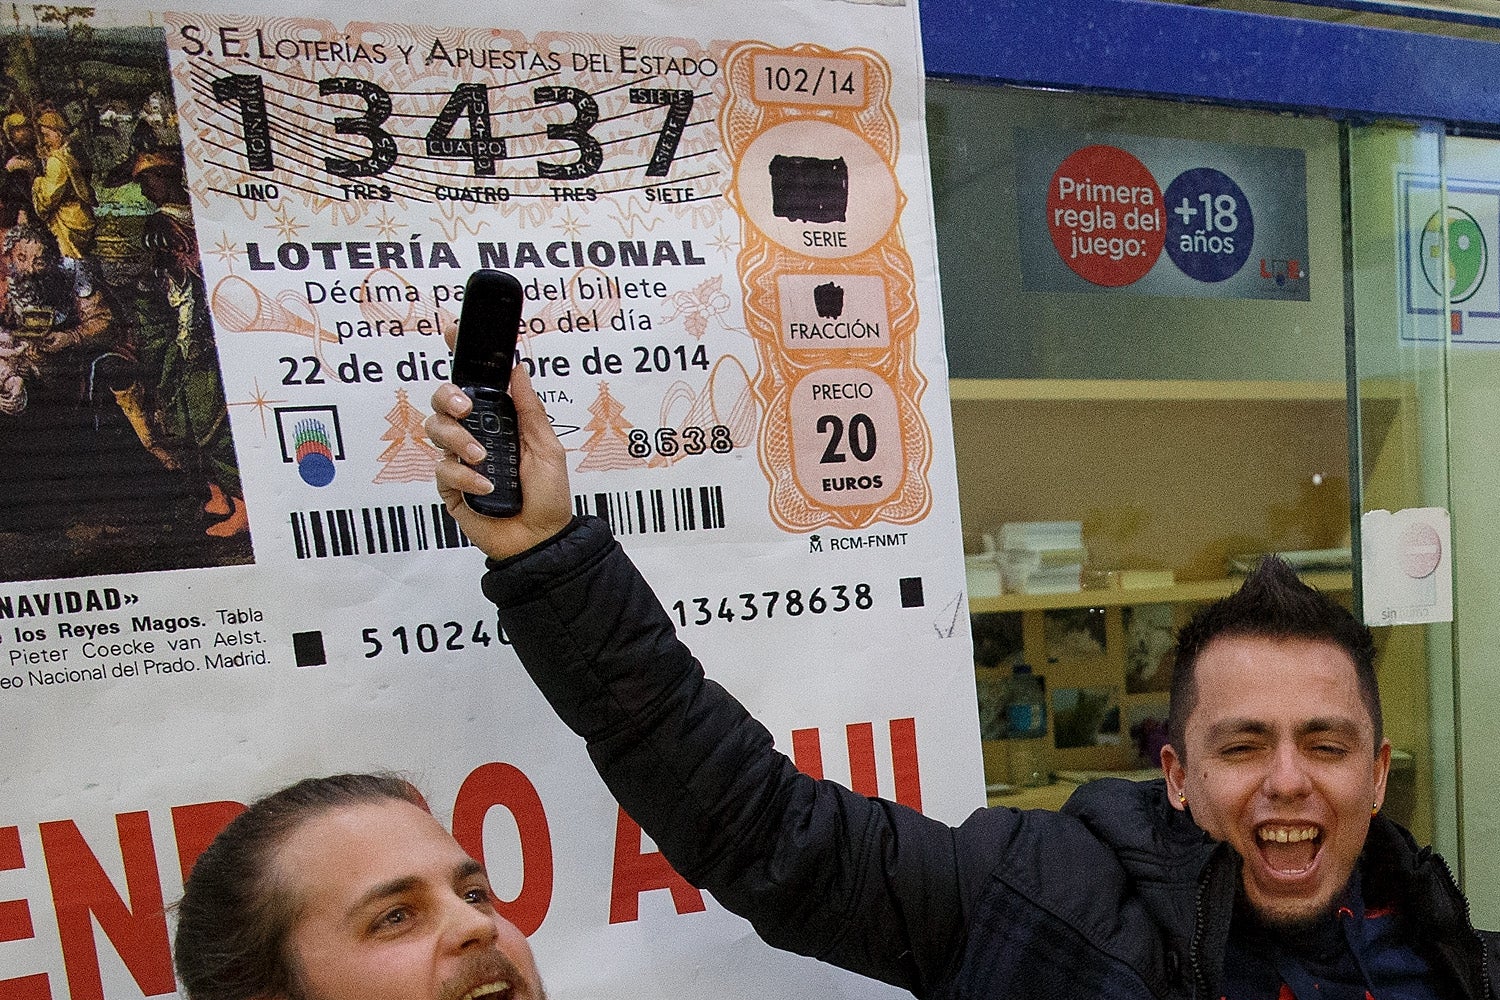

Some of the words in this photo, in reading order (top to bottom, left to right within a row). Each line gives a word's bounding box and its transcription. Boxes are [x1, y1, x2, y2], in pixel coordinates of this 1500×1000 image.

[397, 45, 413, 64] Y
[426, 37, 561, 72] APUESTAS
[572, 52, 613, 73] DEL
[620, 45, 718, 77] ESTADO
[764, 66, 856, 96] 102/14
[237, 184, 279, 200] UNO
[341, 184, 392, 201] TRES
[435, 187, 509, 203] CUATRO
[549, 187, 597, 203] TRES
[645, 187, 696, 203] SIETE
[1058, 177, 1154, 205] Primera
[1053, 206, 1117, 233] regla
[1123, 208, 1161, 231] del
[1174, 192, 1238, 234] +18
[246, 233, 461, 271] LOTERÍA
[478, 240, 706, 268] NACIONAL
[802, 230, 848, 248] SERIE
[1070, 229, 1147, 261] juego:
[1180, 229, 1235, 255] años
[305, 279, 421, 305] Décima
[524, 277, 566, 301] del
[578, 275, 668, 300] billete
[336, 320, 404, 345] para
[417, 312, 441, 336] el
[557, 310, 599, 334] del
[610, 310, 653, 331] día
[790, 318, 880, 340] FRACCIÓN
[279, 356, 325, 386] 22
[338, 353, 383, 384] de
[582, 347, 622, 375] de
[633, 344, 710, 373] 2014
[811, 382, 874, 401] PRECIO
[628, 426, 733, 458] 8638
[816, 412, 877, 464] 20
[821, 474, 884, 492] EUROS
[830, 532, 909, 551] RCM-FNMT
[672, 583, 874, 627] 134378638
[14, 626, 47, 643] los
[58, 621, 121, 640] Reyes
[131, 614, 207, 635] Magos.
[216, 607, 264, 626] Tabla
[10, 648, 69, 667] Pieter
[82, 638, 155, 660] Coecke
[167, 635, 201, 652] van
[213, 629, 268, 648] Aelst.
[29, 662, 108, 688] Nacional
[112, 660, 140, 679] del
[145, 654, 201, 676] Prado.
[205, 649, 271, 671] Madrid.
